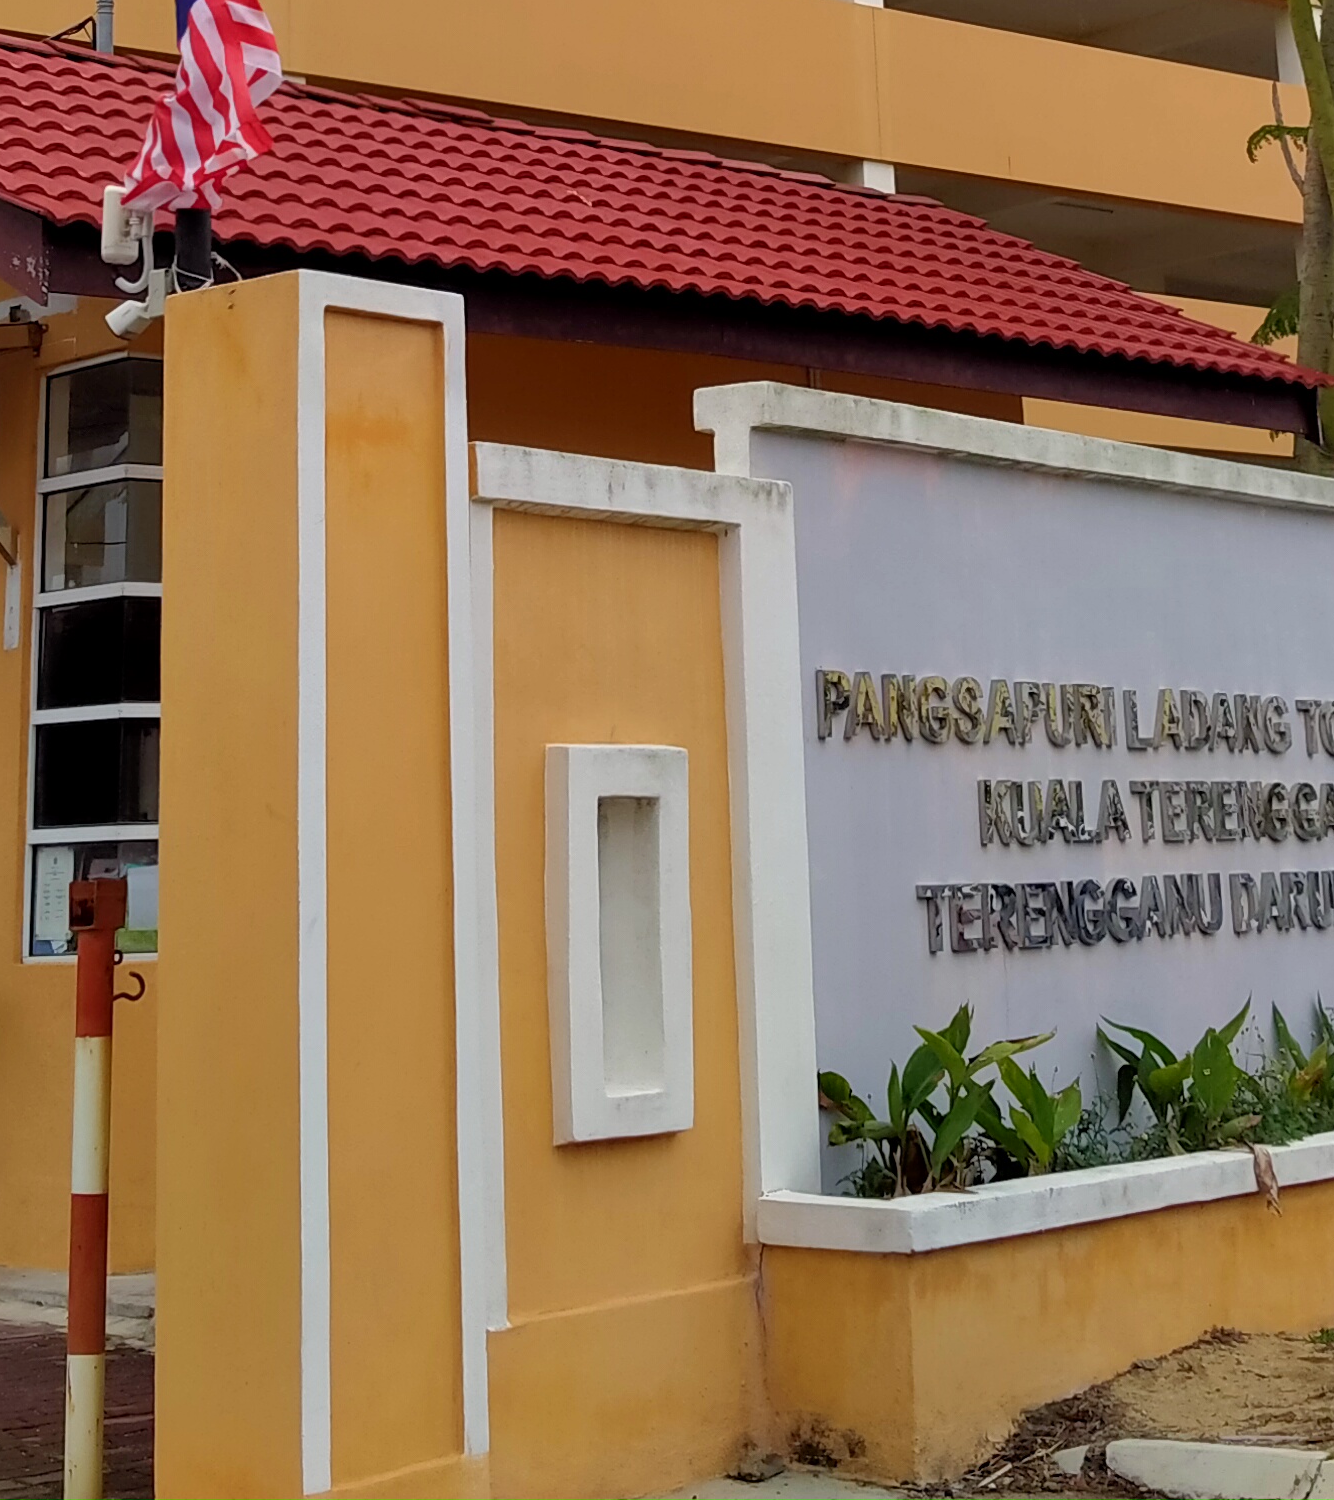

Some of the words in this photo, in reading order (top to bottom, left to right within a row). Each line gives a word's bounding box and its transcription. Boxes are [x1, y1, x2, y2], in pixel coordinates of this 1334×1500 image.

[815, 668, 1118, 749] PANGSAPURI
[1123, 687, 1293, 754] LADANG
[977, 779, 1131, 847] KUALA
[915, 871, 1222, 955] TERENGGANU
